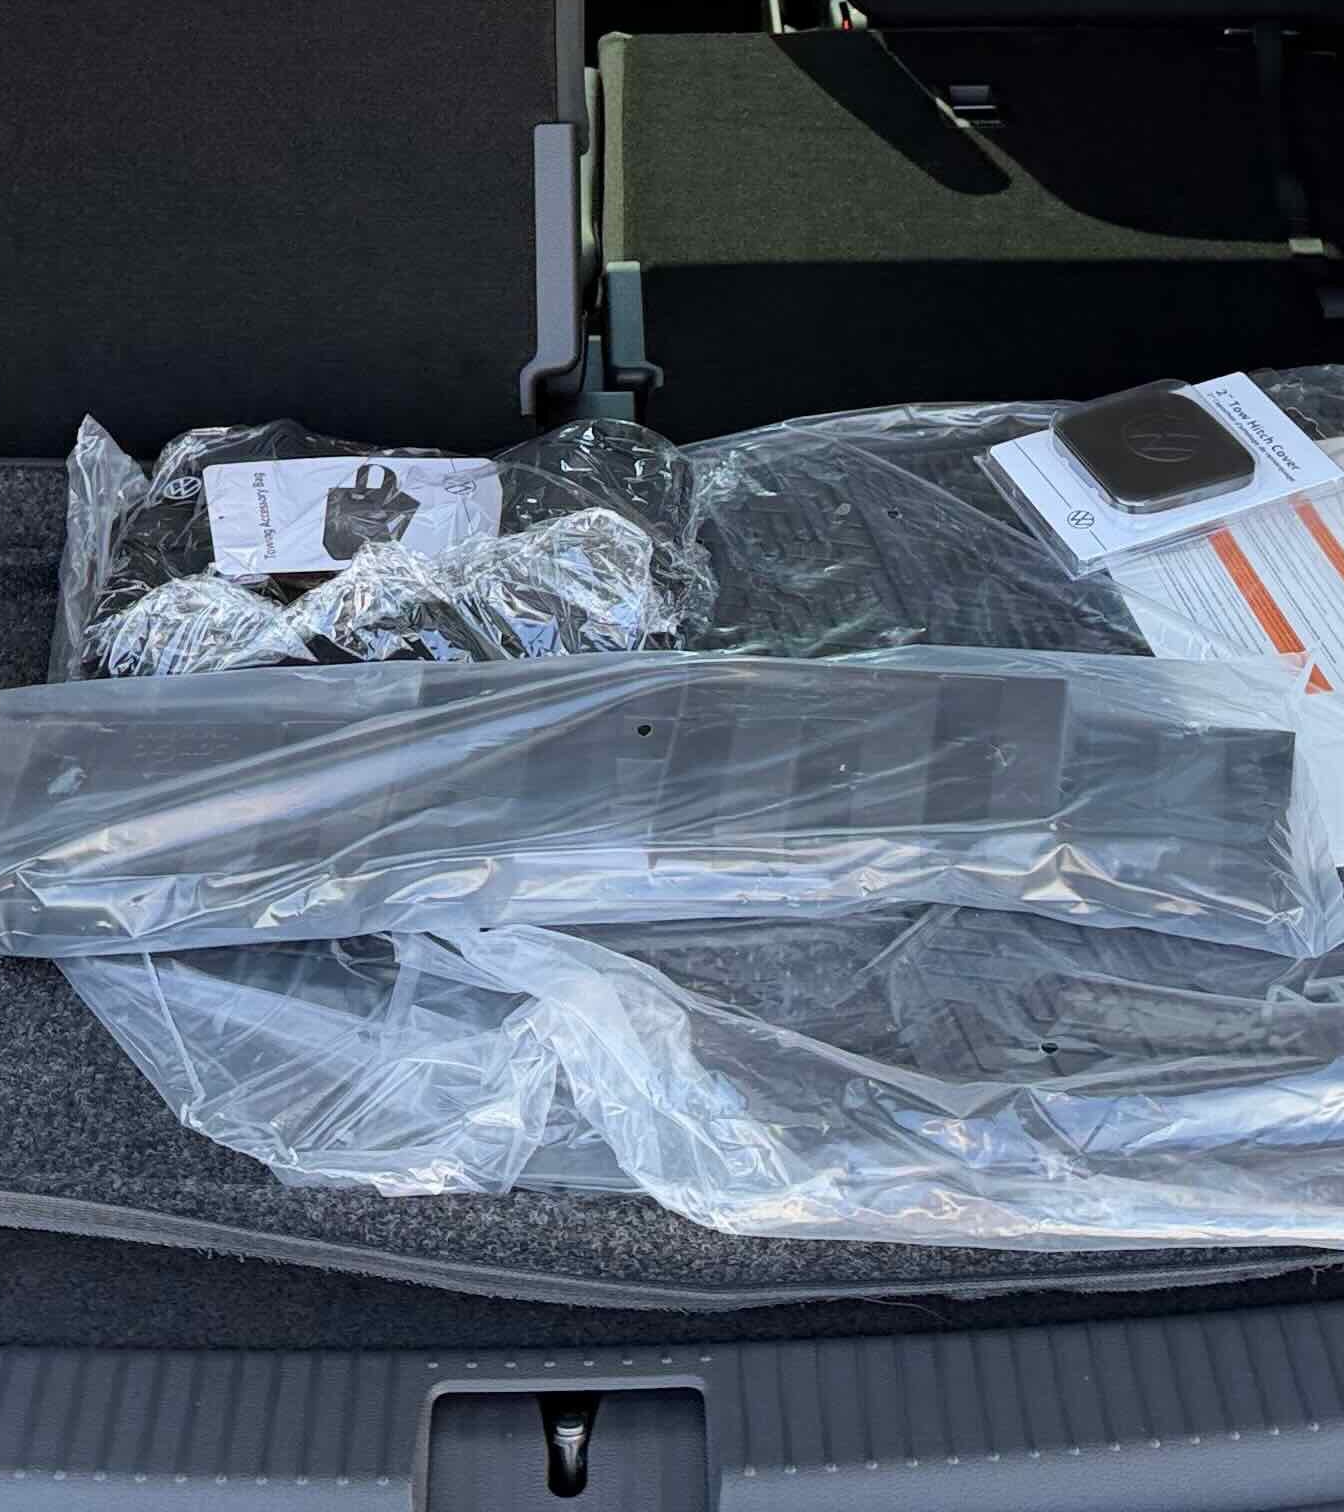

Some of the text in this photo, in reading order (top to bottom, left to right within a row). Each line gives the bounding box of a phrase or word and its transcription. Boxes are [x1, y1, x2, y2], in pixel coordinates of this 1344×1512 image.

[1229, 400, 1252, 421] Tow
[1247, 418, 1274, 445] Hitch
[1271, 444, 1301, 471] Cover
[263, 528, 277, 560] Towing
